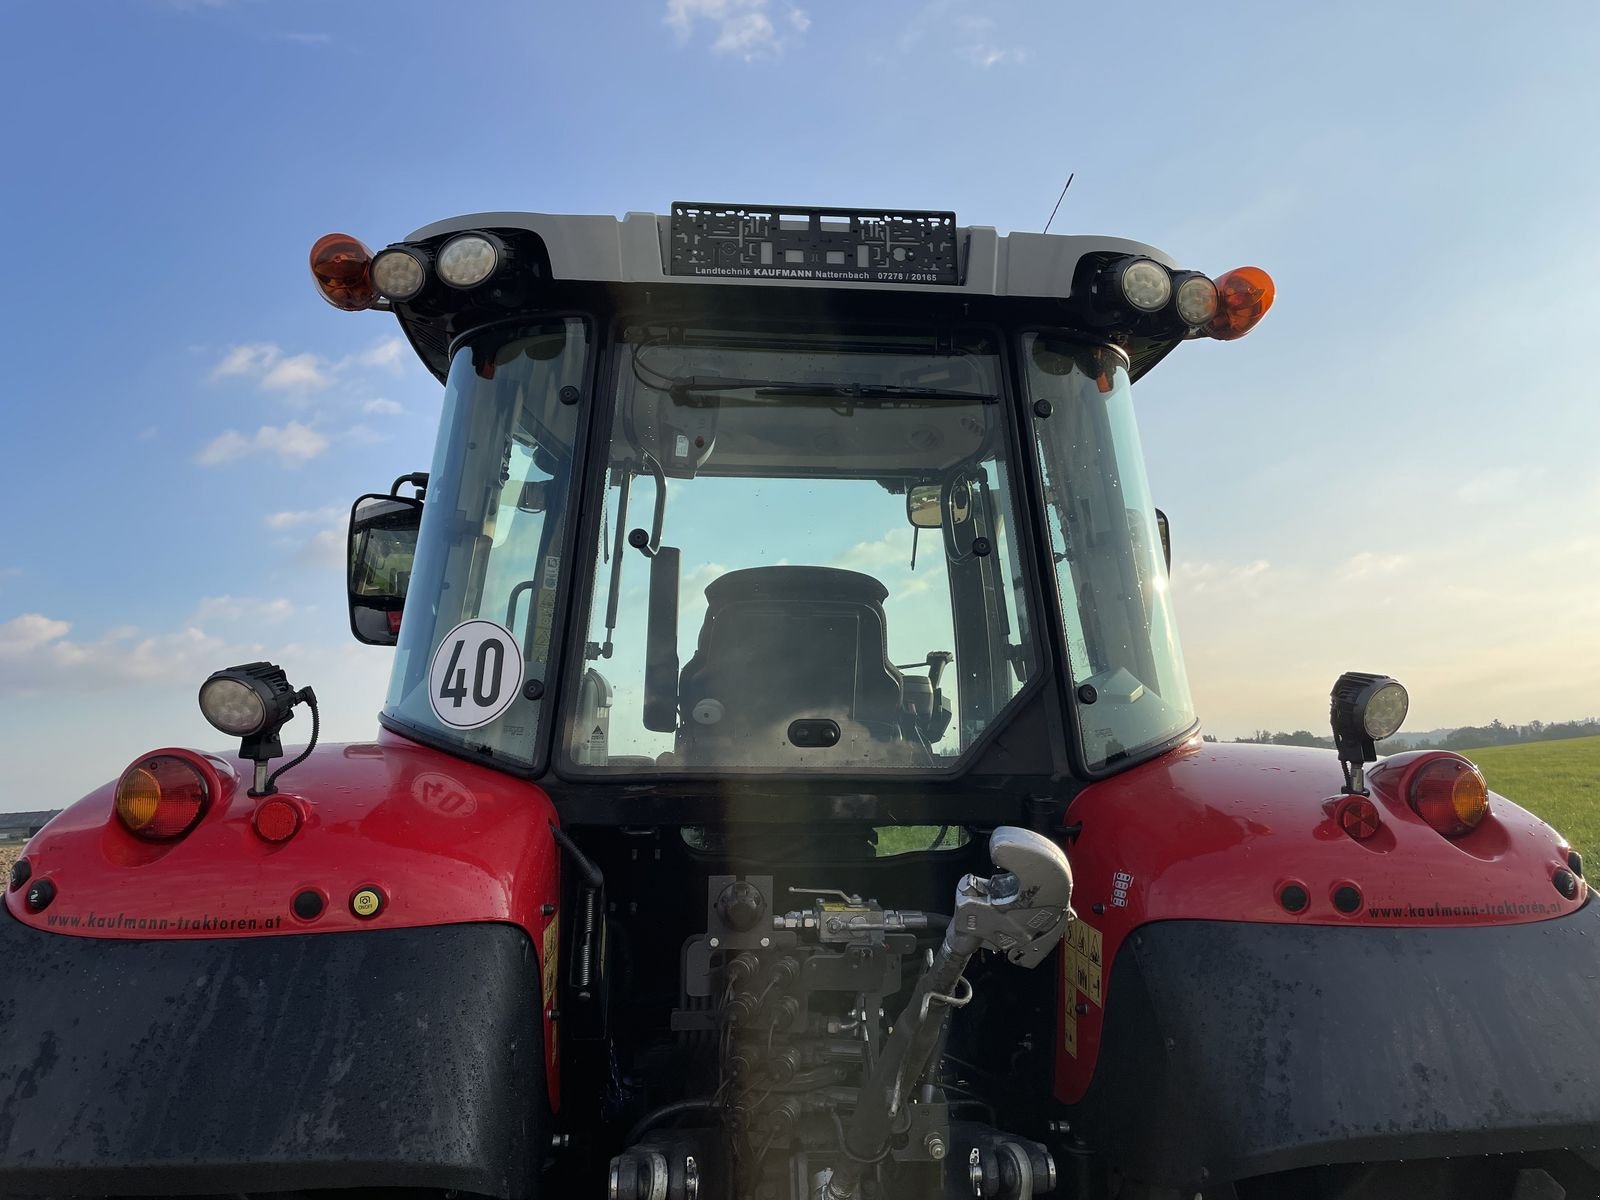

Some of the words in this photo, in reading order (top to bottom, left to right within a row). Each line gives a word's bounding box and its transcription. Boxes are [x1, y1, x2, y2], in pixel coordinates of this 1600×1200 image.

[695, 266, 751, 276] Landtechnik
[753, 268, 812, 278] KAUFMANN
[815, 270, 870, 280] Natternbach
[877, 272, 904, 280] 07278
[911, 273, 937, 282] 20165
[439, 638, 505, 708] 40
[1369, 902, 1562, 918] www.kaufmann-traktoren.at
[47, 912, 281, 930] www.kaufmann-traktoren.at
